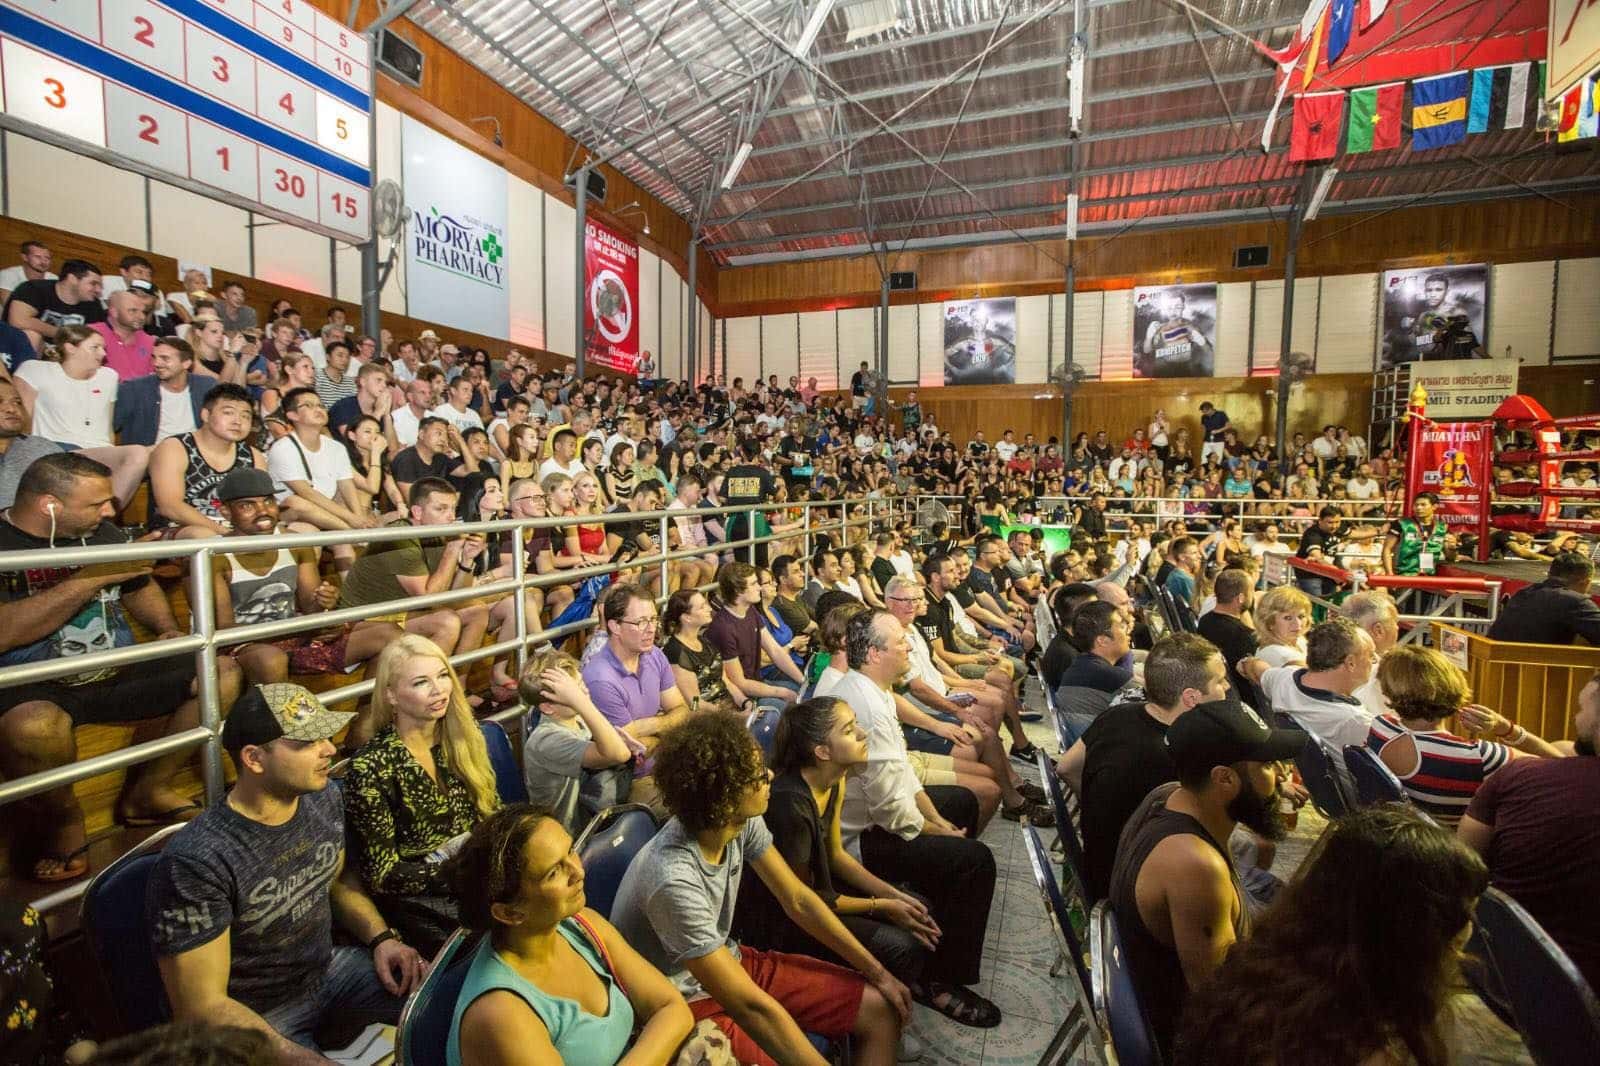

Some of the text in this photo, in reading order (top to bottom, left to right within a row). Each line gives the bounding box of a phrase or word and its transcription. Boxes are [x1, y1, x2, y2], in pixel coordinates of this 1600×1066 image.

[283, 26, 353, 76] 9 10
[338, 32, 348, 48] 5
[134, 15, 349, 141] 2 3 4 5
[43, 77, 358, 219] 3 2 1 30 15
[414, 210, 483, 258] MORYA
[598, 230, 637, 259] SMOKING
[416, 236, 503, 284] PHARMACY
